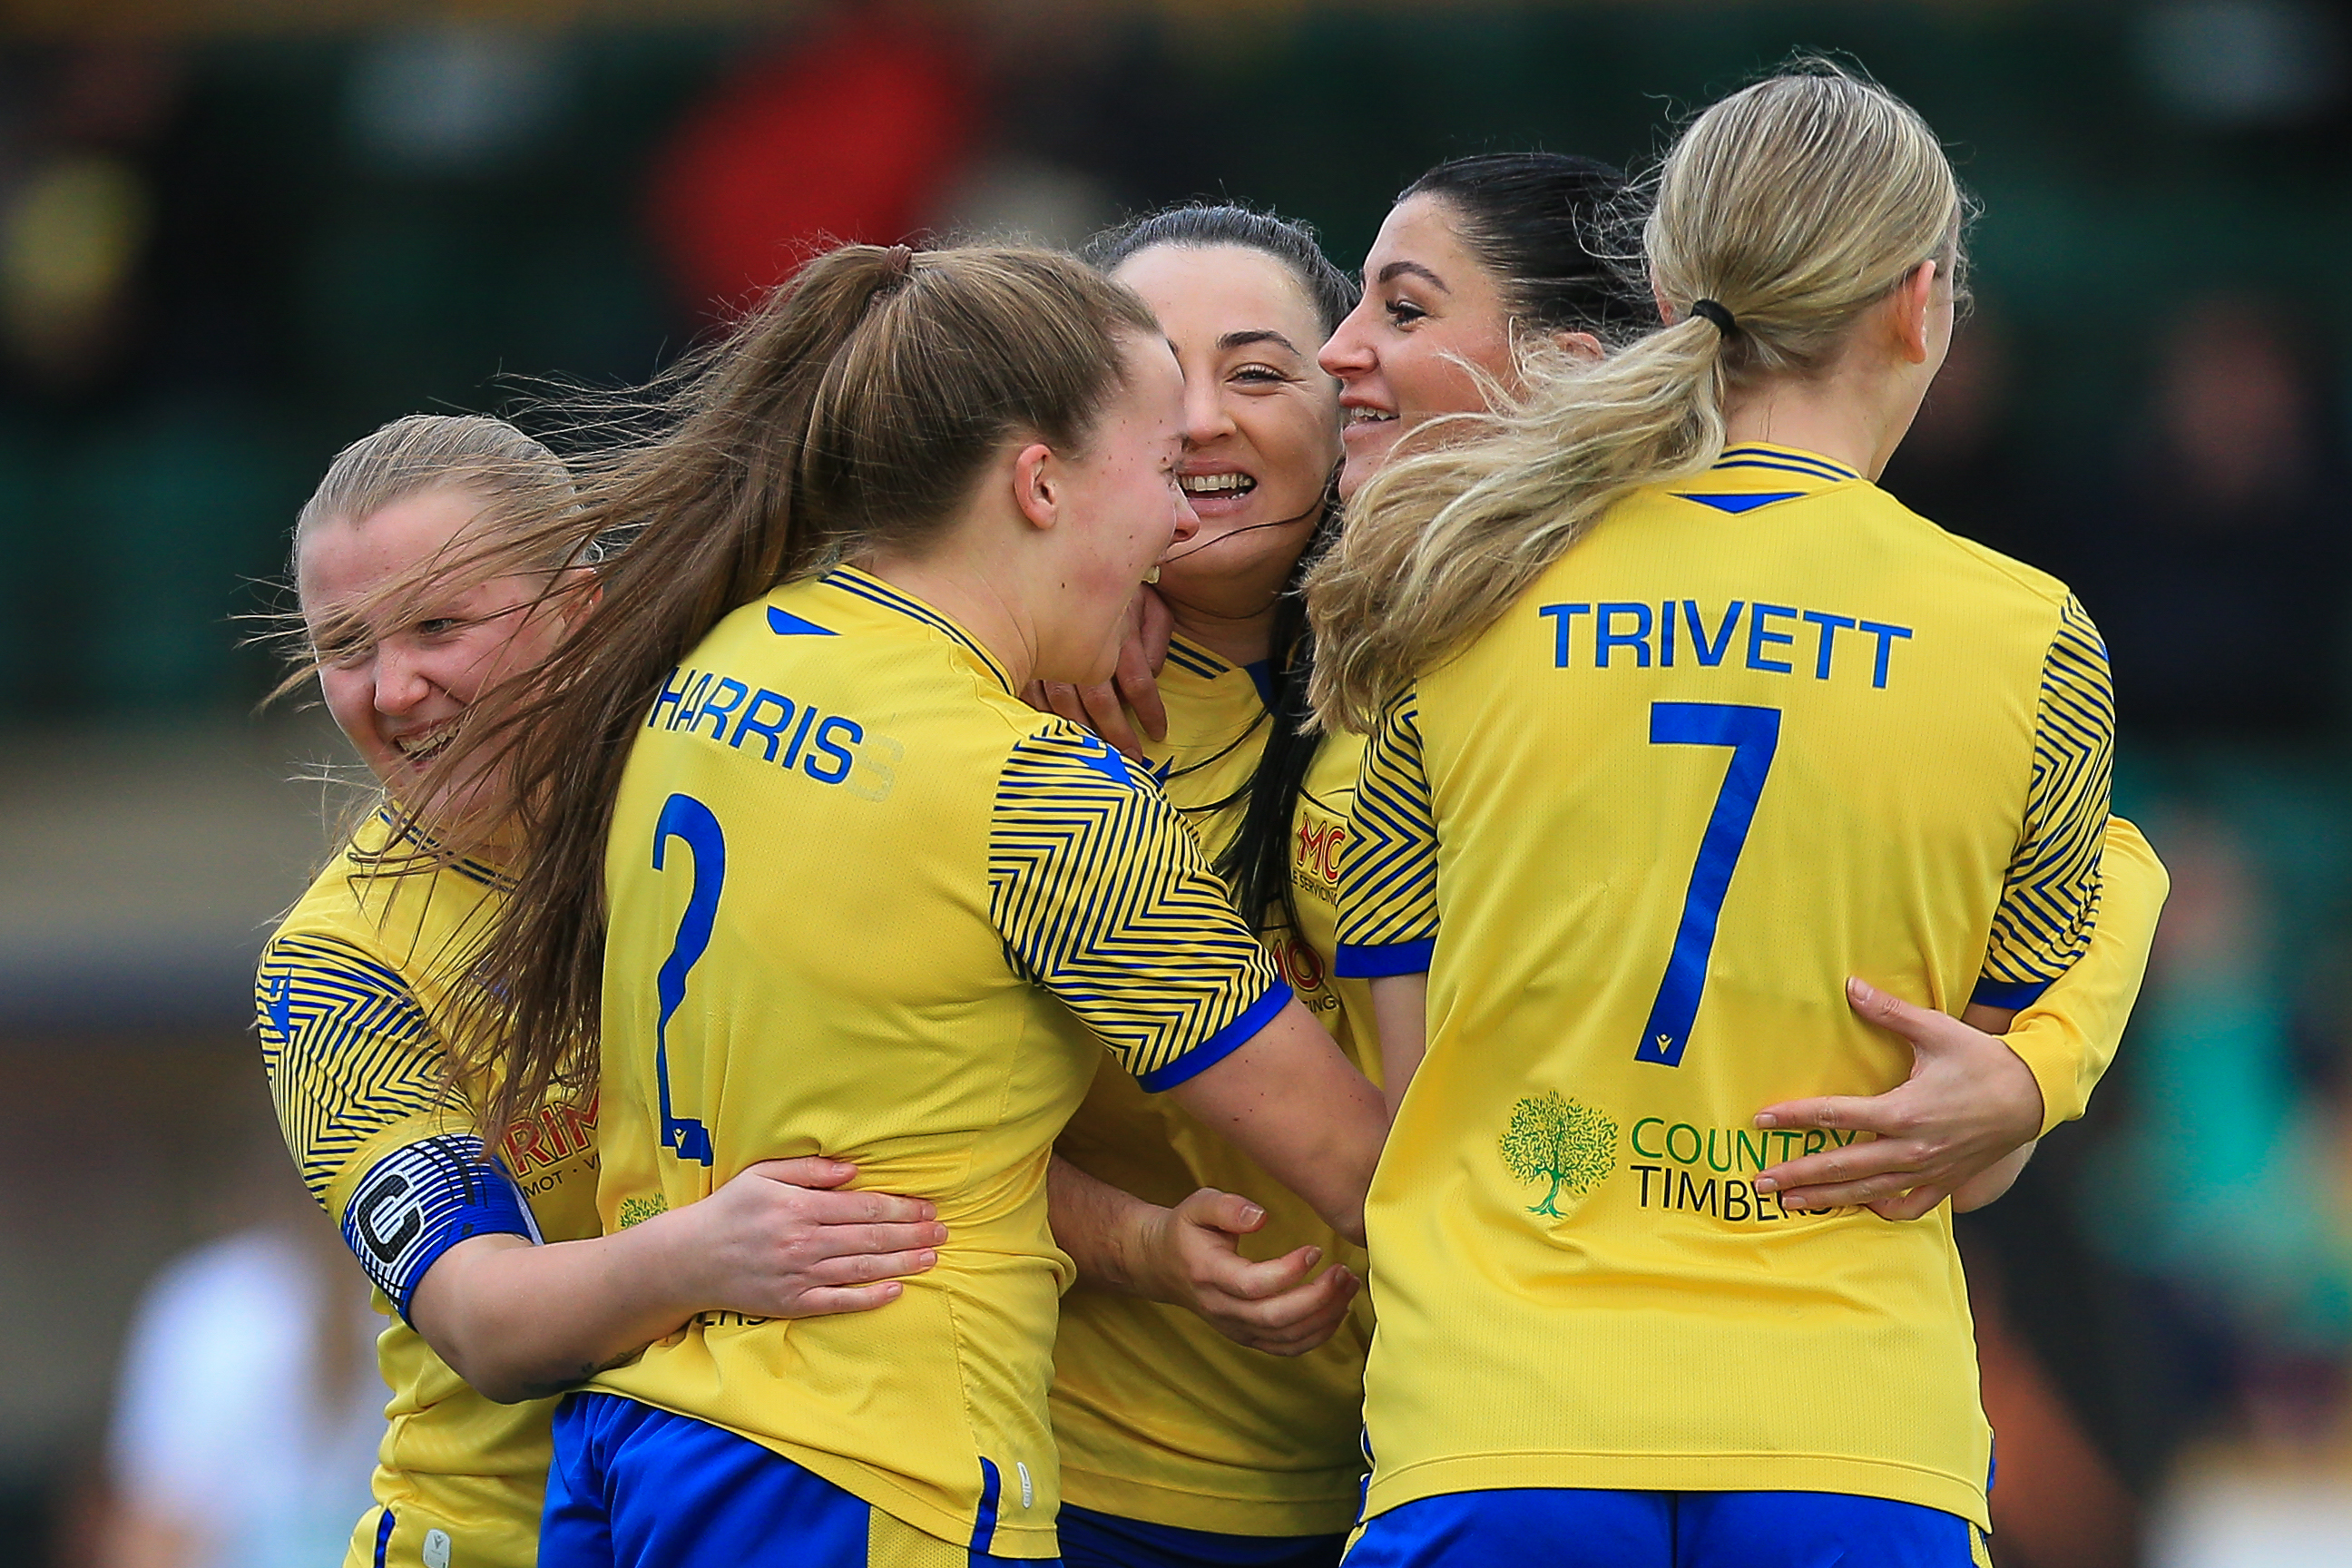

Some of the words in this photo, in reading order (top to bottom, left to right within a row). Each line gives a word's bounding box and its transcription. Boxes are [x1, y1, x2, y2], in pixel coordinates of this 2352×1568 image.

[1538, 599, 1914, 690] TRIVETT
[646, 666, 864, 785] HARRIS
[1634, 701, 1783, 1068] 7
[652, 793, 727, 1168] 2
[357, 1173, 417, 1265] C
[523, 1170, 564, 1199] MOT
[1630, 1165, 1833, 1221] TIMBE
